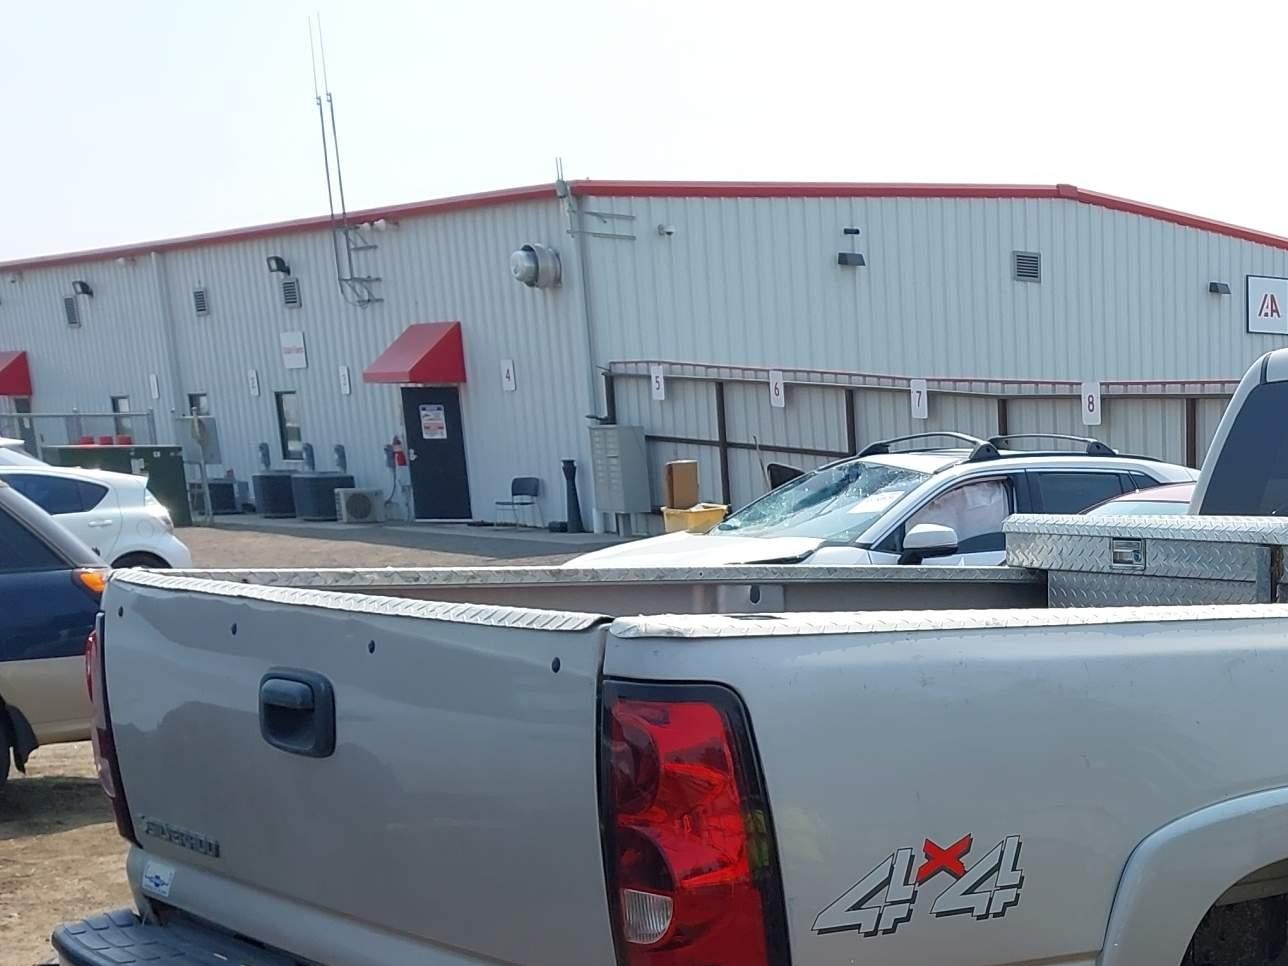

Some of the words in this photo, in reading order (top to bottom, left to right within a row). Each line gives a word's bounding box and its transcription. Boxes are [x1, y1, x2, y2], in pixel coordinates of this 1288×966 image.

[654, 375, 662, 391] 5
[773, 381, 780, 397] 6
[915, 390, 923, 408] 7
[1087, 394, 1096, 412] 8
